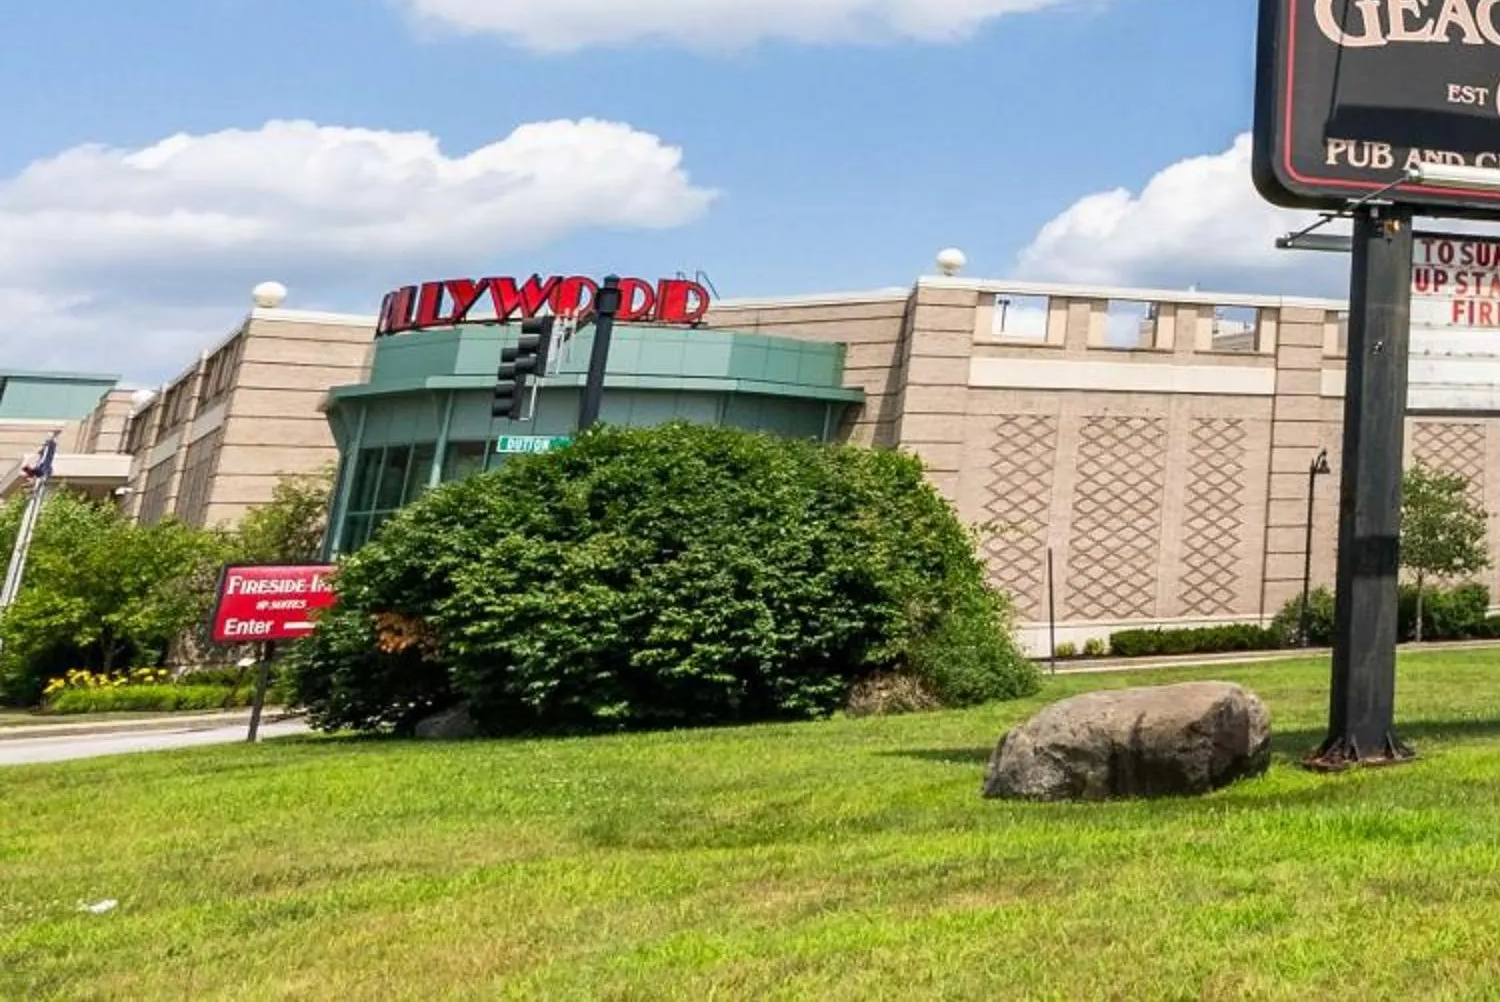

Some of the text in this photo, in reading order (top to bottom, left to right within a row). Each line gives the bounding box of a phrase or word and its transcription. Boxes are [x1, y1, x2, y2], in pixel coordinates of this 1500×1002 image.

[1447, 83, 1489, 106] EST
[1325, 137, 1395, 170] PUB
[1402, 147, 1465, 171] AND
[1420, 238, 1455, 265] TO
[1414, 267, 1449, 293] UP
[226, 575, 307, 595] FIRESIDE
[223, 618, 275, 636] Enter
